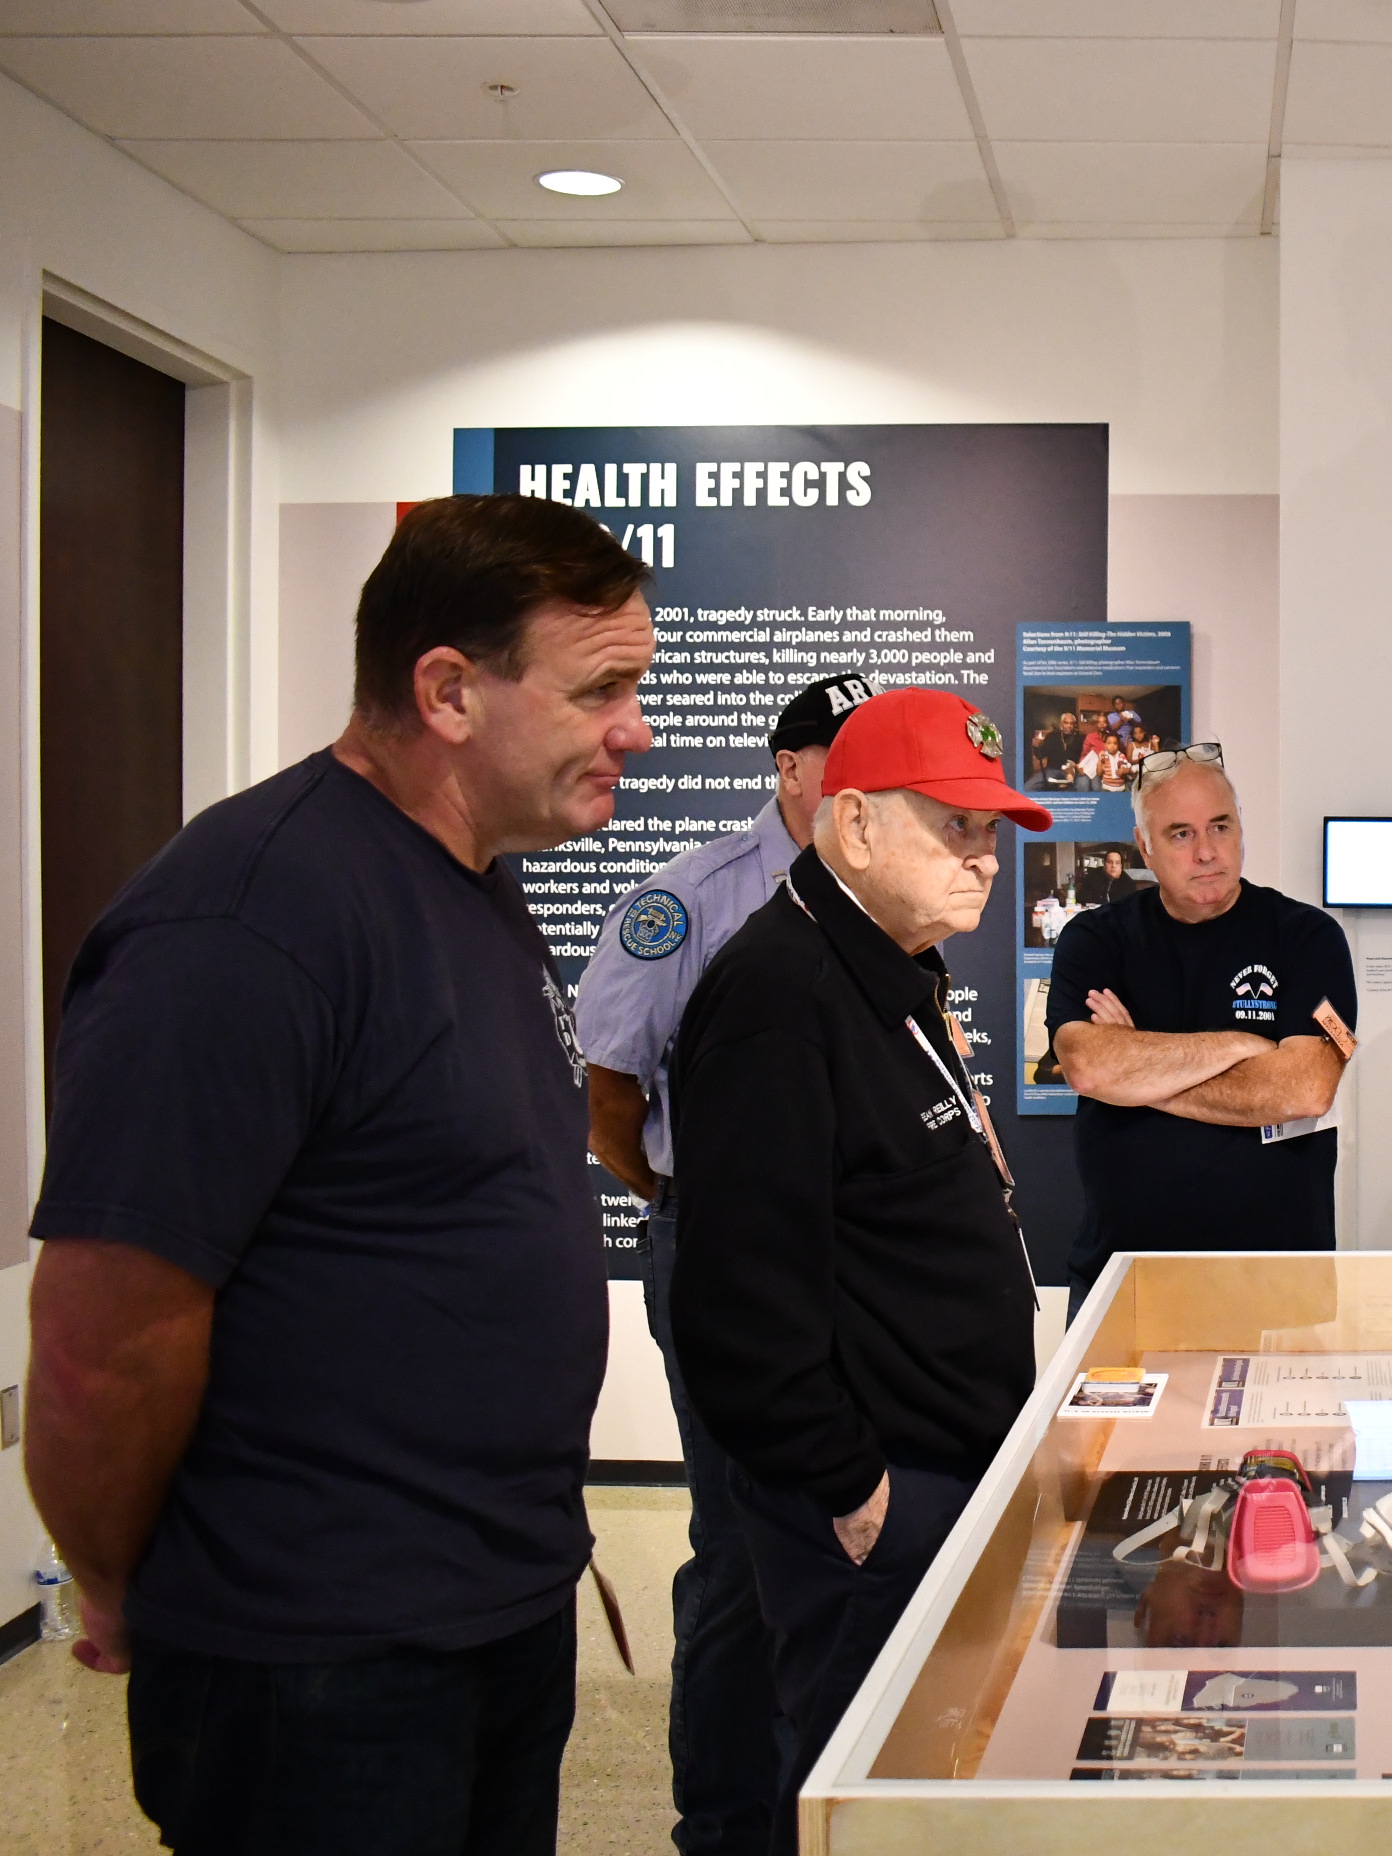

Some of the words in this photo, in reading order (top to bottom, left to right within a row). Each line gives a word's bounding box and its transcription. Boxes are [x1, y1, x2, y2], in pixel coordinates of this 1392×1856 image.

[520, 463, 676, 507] HEALTH
[696, 462, 871, 506] EFFECTS
[600, 523, 675, 568] /11
[655, 608, 694, 623] 2001,
[697, 606, 754, 624] tragedy
[757, 606, 804, 621] struck.
[808, 606, 843, 624] Early
[846, 606, 876, 621] that
[880, 607, 946, 624] morning,
[653, 628, 683, 644] four
[686, 627, 770, 642] commercial
[773, 627, 839, 645] airplanes
[842, 627, 870, 642] and
[874, 628, 931, 642] crashed
[934, 628, 973, 642] them
[694, 650, 769, 664] structures,
[773, 648, 816, 666] killing
[820, 648, 866, 666] nearly
[869, 649, 908, 664] 3,000
[912, 649, 963, 666] people
[966, 649, 994, 663] and
[660, 670, 692, 684] who
[695, 673, 731, 684] were
[734, 670, 766, 684] able
[768, 671, 784, 684] to
[869, 670, 958, 684] devastation.
[961, 670, 988, 684] The
[666, 691, 714, 705] seared
[718, 691, 746, 705] into
[749, 690, 774, 705] the
[642, 712, 682, 729] eople
[685, 712, 737, 726] around
[741, 712, 766, 726] the
[670, 733, 703, 747] time
[706, 736, 725, 747] on
[619, 775, 675, 792] tragedy
[678, 775, 702, 789] did
[705, 776, 730, 789] not
[733, 775, 761, 789] end
[647, 817, 672, 831] the
[675, 817, 716, 834] plane
[609, 838, 702, 855] Pennsylvania
[523, 858, 596, 872] hazardous
[522, 879, 579, 893] workers
[582, 880, 609, 894] and
[637, 893, 684, 927] TECHNICAL
[623, 918, 638, 951] RESCUE
[638, 941, 676, 957] SCHOOL
[1230, 965, 1253, 990] NEVER
[1253, 964, 1279, 990] FORGET
[1235, 1010, 1275, 1021] 09.11.2001
